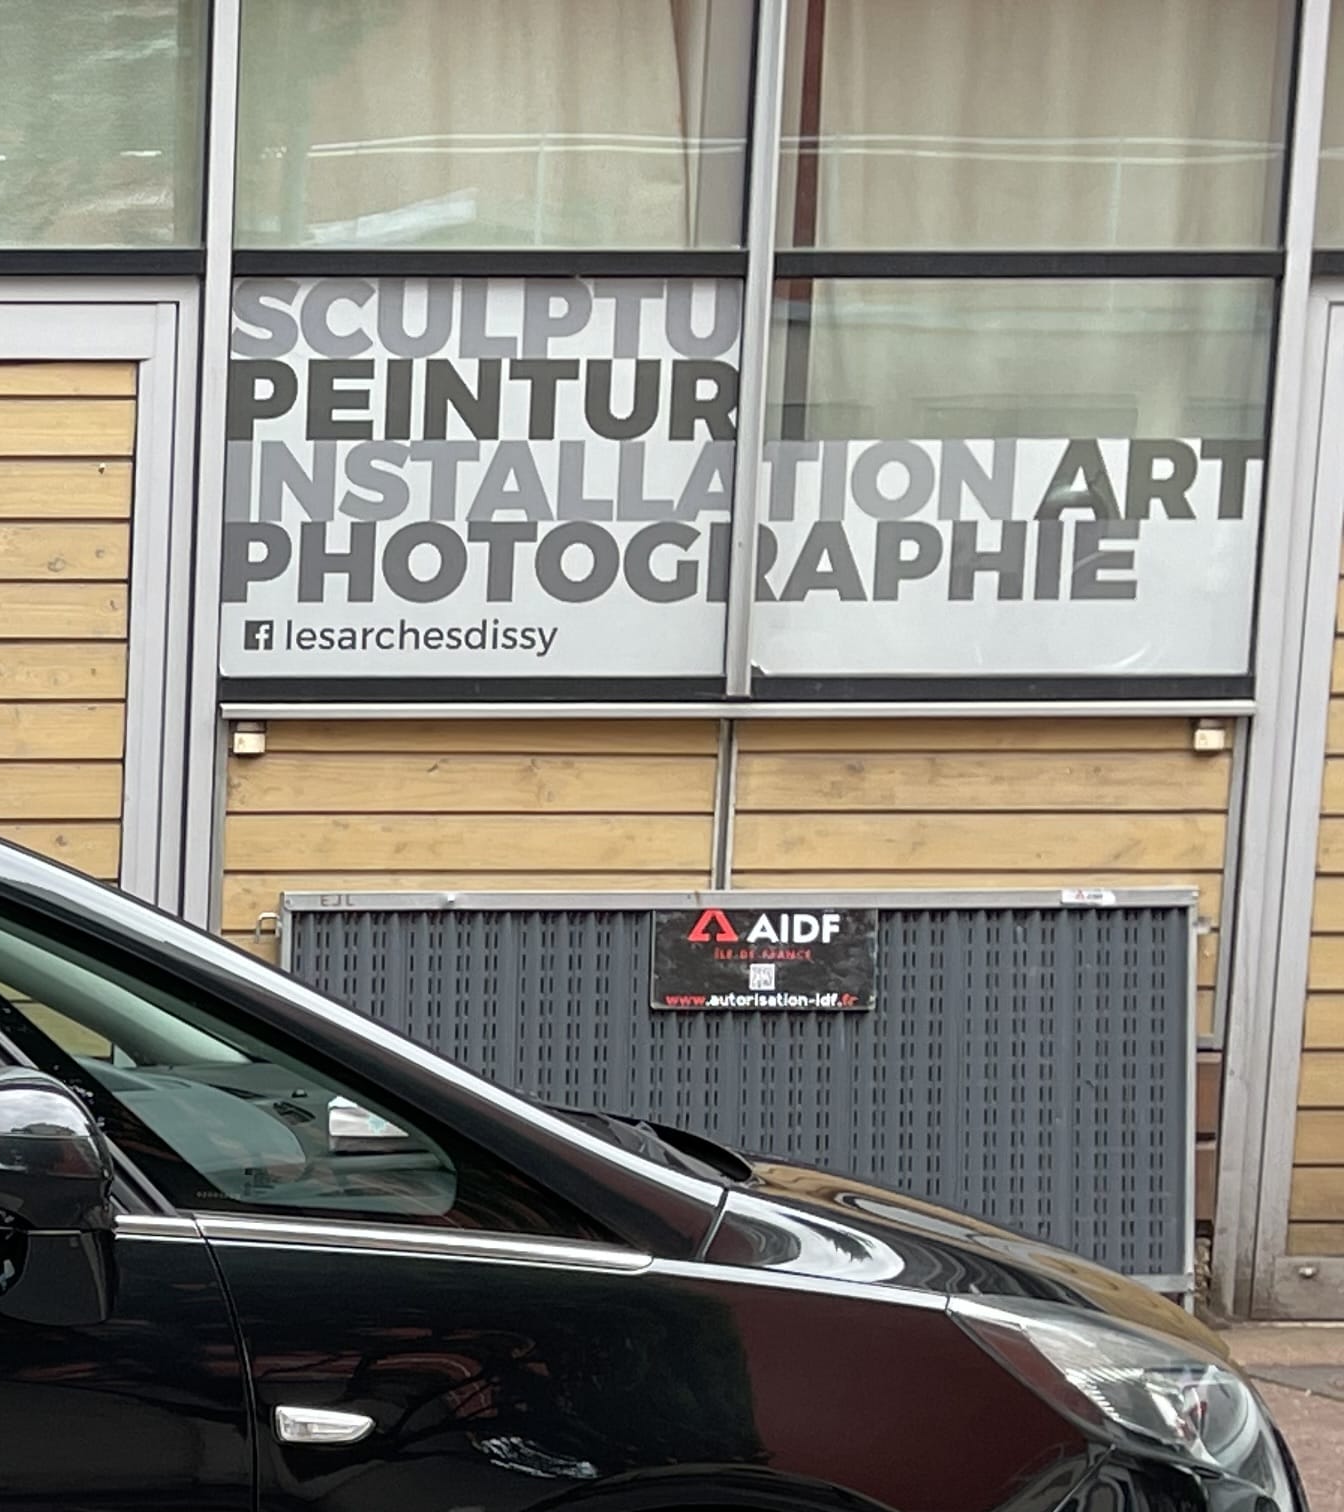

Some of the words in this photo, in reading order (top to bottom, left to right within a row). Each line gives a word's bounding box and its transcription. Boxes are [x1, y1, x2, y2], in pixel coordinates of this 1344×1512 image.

[224, 440, 1016, 522] INSTALLATION
[1033, 438, 1264, 520] ART
[220, 520, 1140, 603] PHOTOGRAPHIE
[286, 619, 558, 656] lesarchesdissy
[747, 913, 840, 943] AIDF
[665, 992, 859, 1007] www.autorisation-idf.fr
